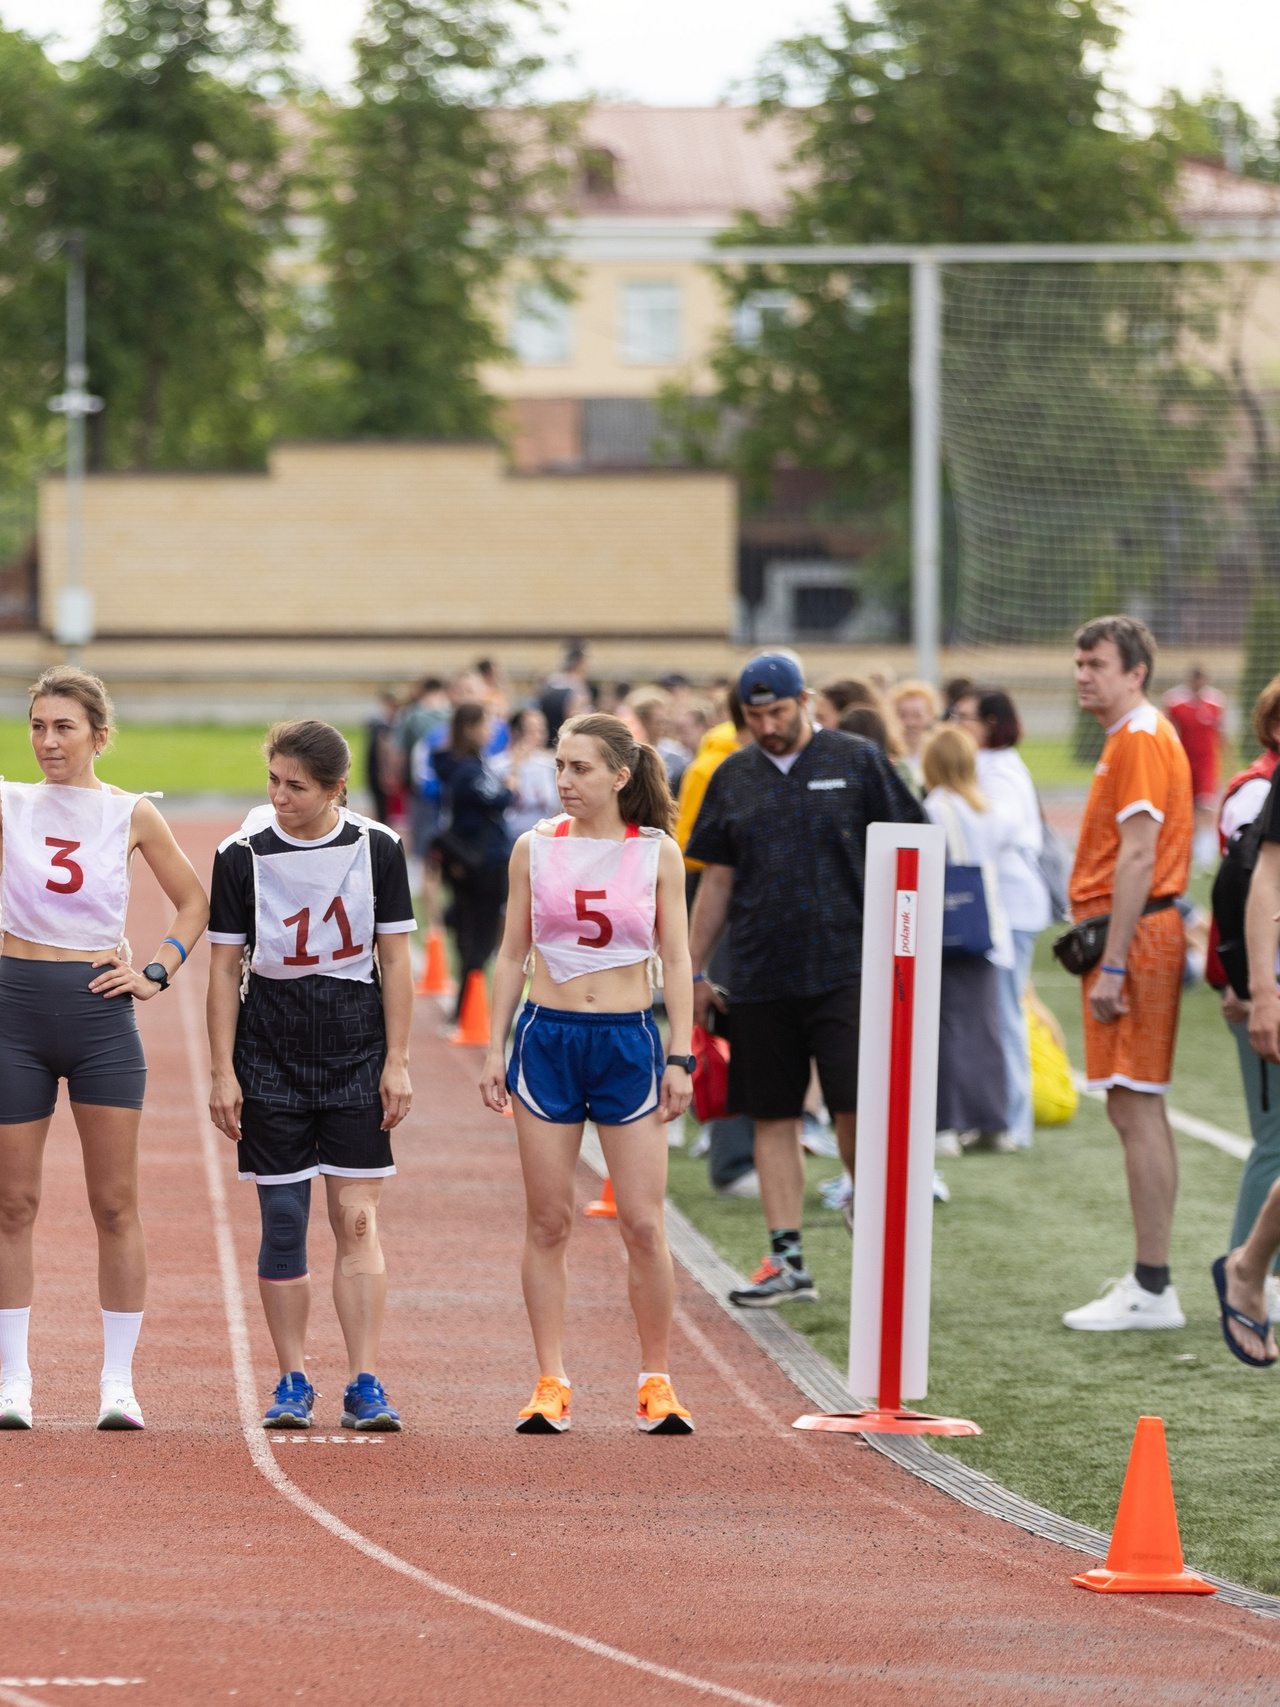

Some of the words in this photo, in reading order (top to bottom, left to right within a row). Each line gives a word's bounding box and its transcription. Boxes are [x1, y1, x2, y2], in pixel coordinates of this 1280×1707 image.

[45, 836, 84, 894] 3
[282, 896, 363, 966] 11
[575, 889, 613, 948] 5
[900, 911, 911, 954] polanik
